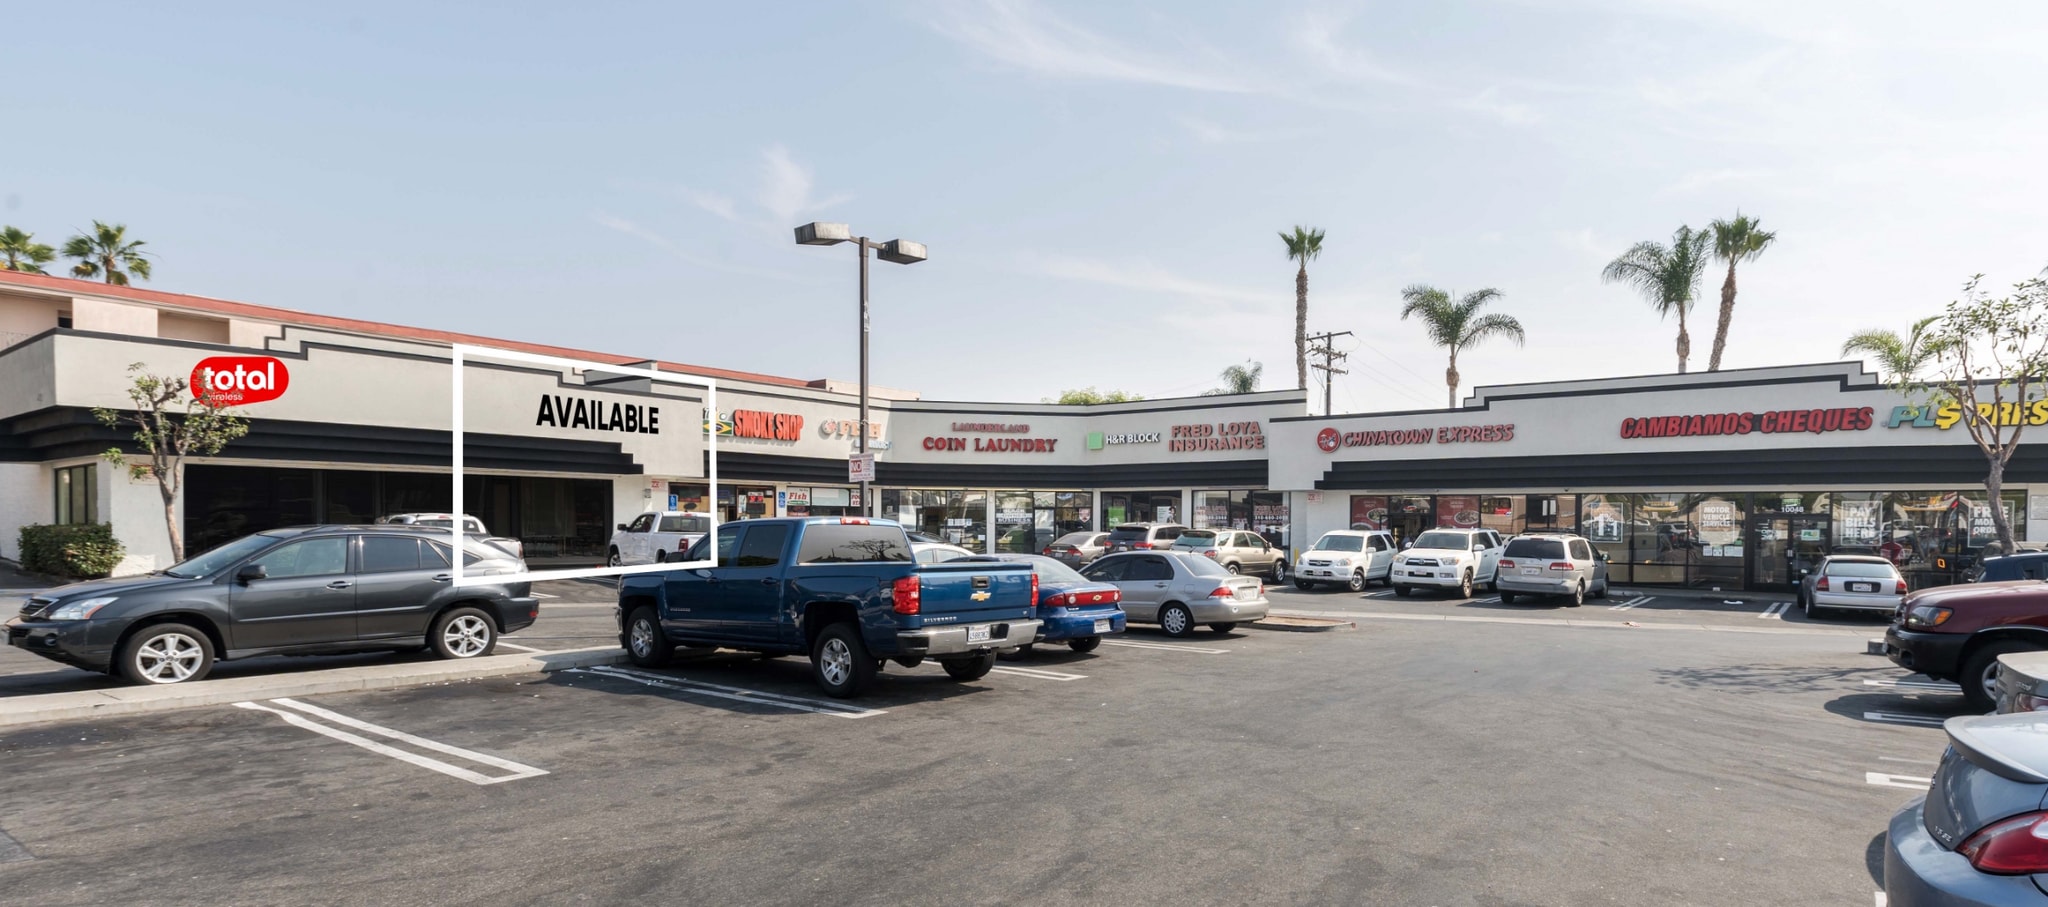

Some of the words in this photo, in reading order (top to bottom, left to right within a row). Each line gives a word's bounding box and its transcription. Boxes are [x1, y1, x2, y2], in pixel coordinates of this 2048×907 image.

[204, 361, 274, 391] total
[733, 409, 775, 439] SMOKE
[774, 413, 804, 441] SHOP
[952, 422, 1030, 433] LAUNDERLAND
[1171, 424, 1212, 438] FRED
[1218, 421, 1261, 435] LOYA
[1620, 413, 1753, 439] CAMBIAMOS
[1760, 407, 1873, 434] CHEQUES
[1106, 435, 1125, 445] H&R
[1127, 433, 1160, 443] BLOCK
[1342, 428, 1433, 447] CHINATOWN
[1437, 424, 1514, 443] EXPRESS
[923, 437, 966, 451] COIN
[974, 438, 1058, 452] LAUNDRY
[1168, 436, 1265, 452] INSURANCE
[789, 492, 807, 500] Fish
[1850, 507, 1873, 517] PAY
[1973, 506, 2009, 517] FRE
[1845, 517, 1876, 527] BILLS
